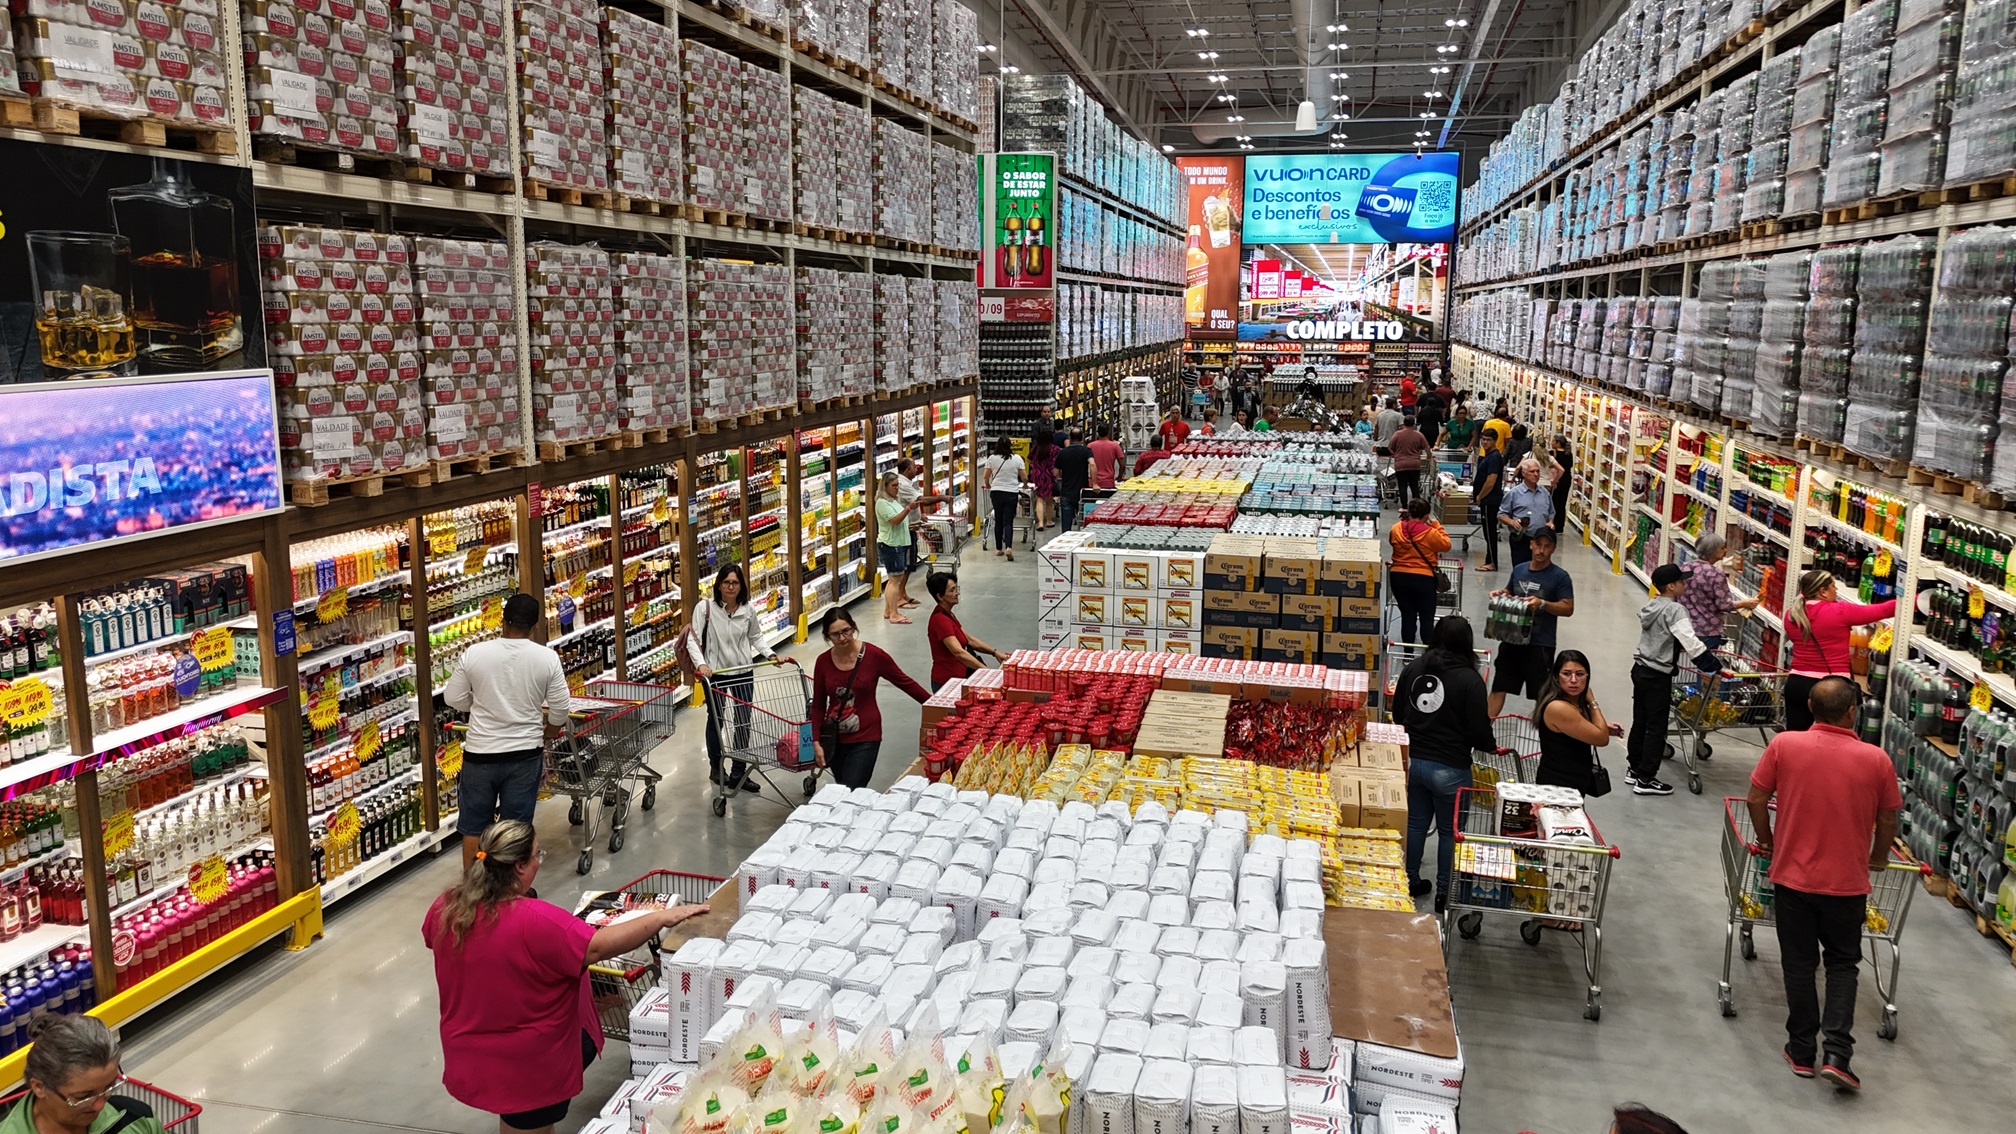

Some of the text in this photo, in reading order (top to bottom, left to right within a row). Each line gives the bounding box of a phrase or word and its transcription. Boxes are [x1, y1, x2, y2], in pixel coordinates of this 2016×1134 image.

[92, 1, 120, 13] AMSTEL
[367, 5, 385, 15] AMSTEL
[139, 13, 166, 24] AMSTEL
[270, 13, 293, 25] AMSTEL
[186, 22, 210, 34] AMSTEL
[307, 22, 326, 33] AMSTEL
[344, 29, 362, 39] AMSTEL
[64, 35, 99, 47] VALIDADE
[113, 43, 140, 54] AMSTEL
[160, 51, 185, 62] AMSTEL
[300, 50, 320, 60] AMSTEL
[334, 60, 354, 69] AMSTEL
[371, 68, 390, 77] AMSTEL
[150, 89, 175, 99] AMSTEL
[348, 93, 367, 103] AMSTEL
[196, 96, 220, 106] AMSTEL
[340, 122, 359, 132] AMSTEL
[1003, 172, 1046, 180] O SABOR
[1184, 167, 1228, 176] TODO MUNDO
[1003, 181, 1046, 189] DE ESTAR
[1197, 177, 1206, 185] UM
[1009, 189, 1039, 198] JUNTO
[1253, 188, 1341, 203] Descontos
[1251, 205, 1350, 220] e benefíos
[1299, 218, 1357, 230] exclusivos
[298, 269, 318, 277] AMSTEL
[368, 274, 385, 282] AMSTEL
[364, 301, 382, 309] AMSTEL
[1211, 309, 1228, 319] QUAL
[1210, 320, 1235, 329] O SEU?
[1286, 320, 1404, 341] COMPLETO
[373, 332, 391, 340] AMSTEL
[316, 423, 349, 432] VALIDADE
[375, 419, 393, 427] AMSTEL
[1221, 562, 1244, 570] Corona
[1280, 565, 1304, 573] Corona
[1212, 596, 1233, 604] Corona
[182, 715, 222, 735] Tanqueray
[1504, 805, 1520, 815] 32
[1295, 982, 1304, 1024] NORDESTE
[633, 1028, 667, 1038] NORDESTE
[1371, 1066, 1415, 1080] NORDESTE
[1394, 1110, 1446, 1121] NORDESTE
